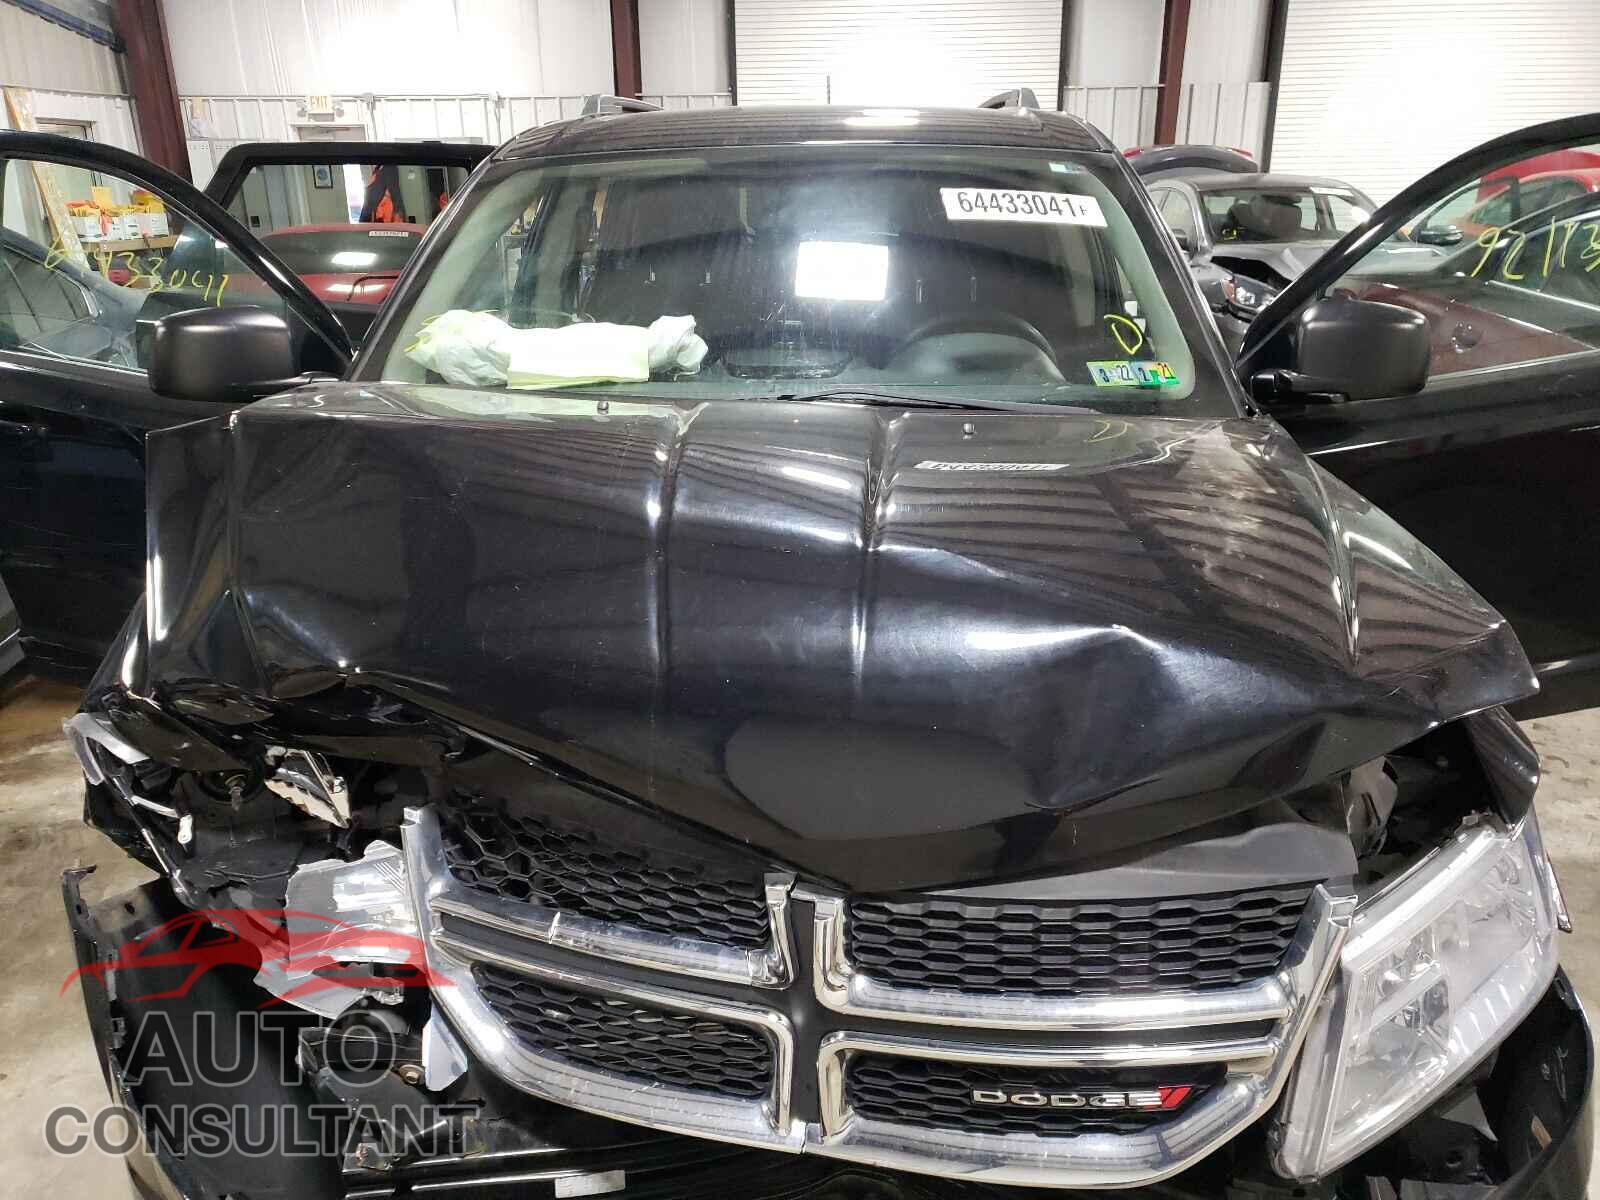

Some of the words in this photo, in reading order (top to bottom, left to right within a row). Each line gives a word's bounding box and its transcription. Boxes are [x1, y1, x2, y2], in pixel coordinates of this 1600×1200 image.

[309, 95, 328, 112] EXIT
[957, 191, 1077, 217] 64433041
[1116, 364, 1134, 381] 22
[971, 1088, 1163, 1108] DODGE
